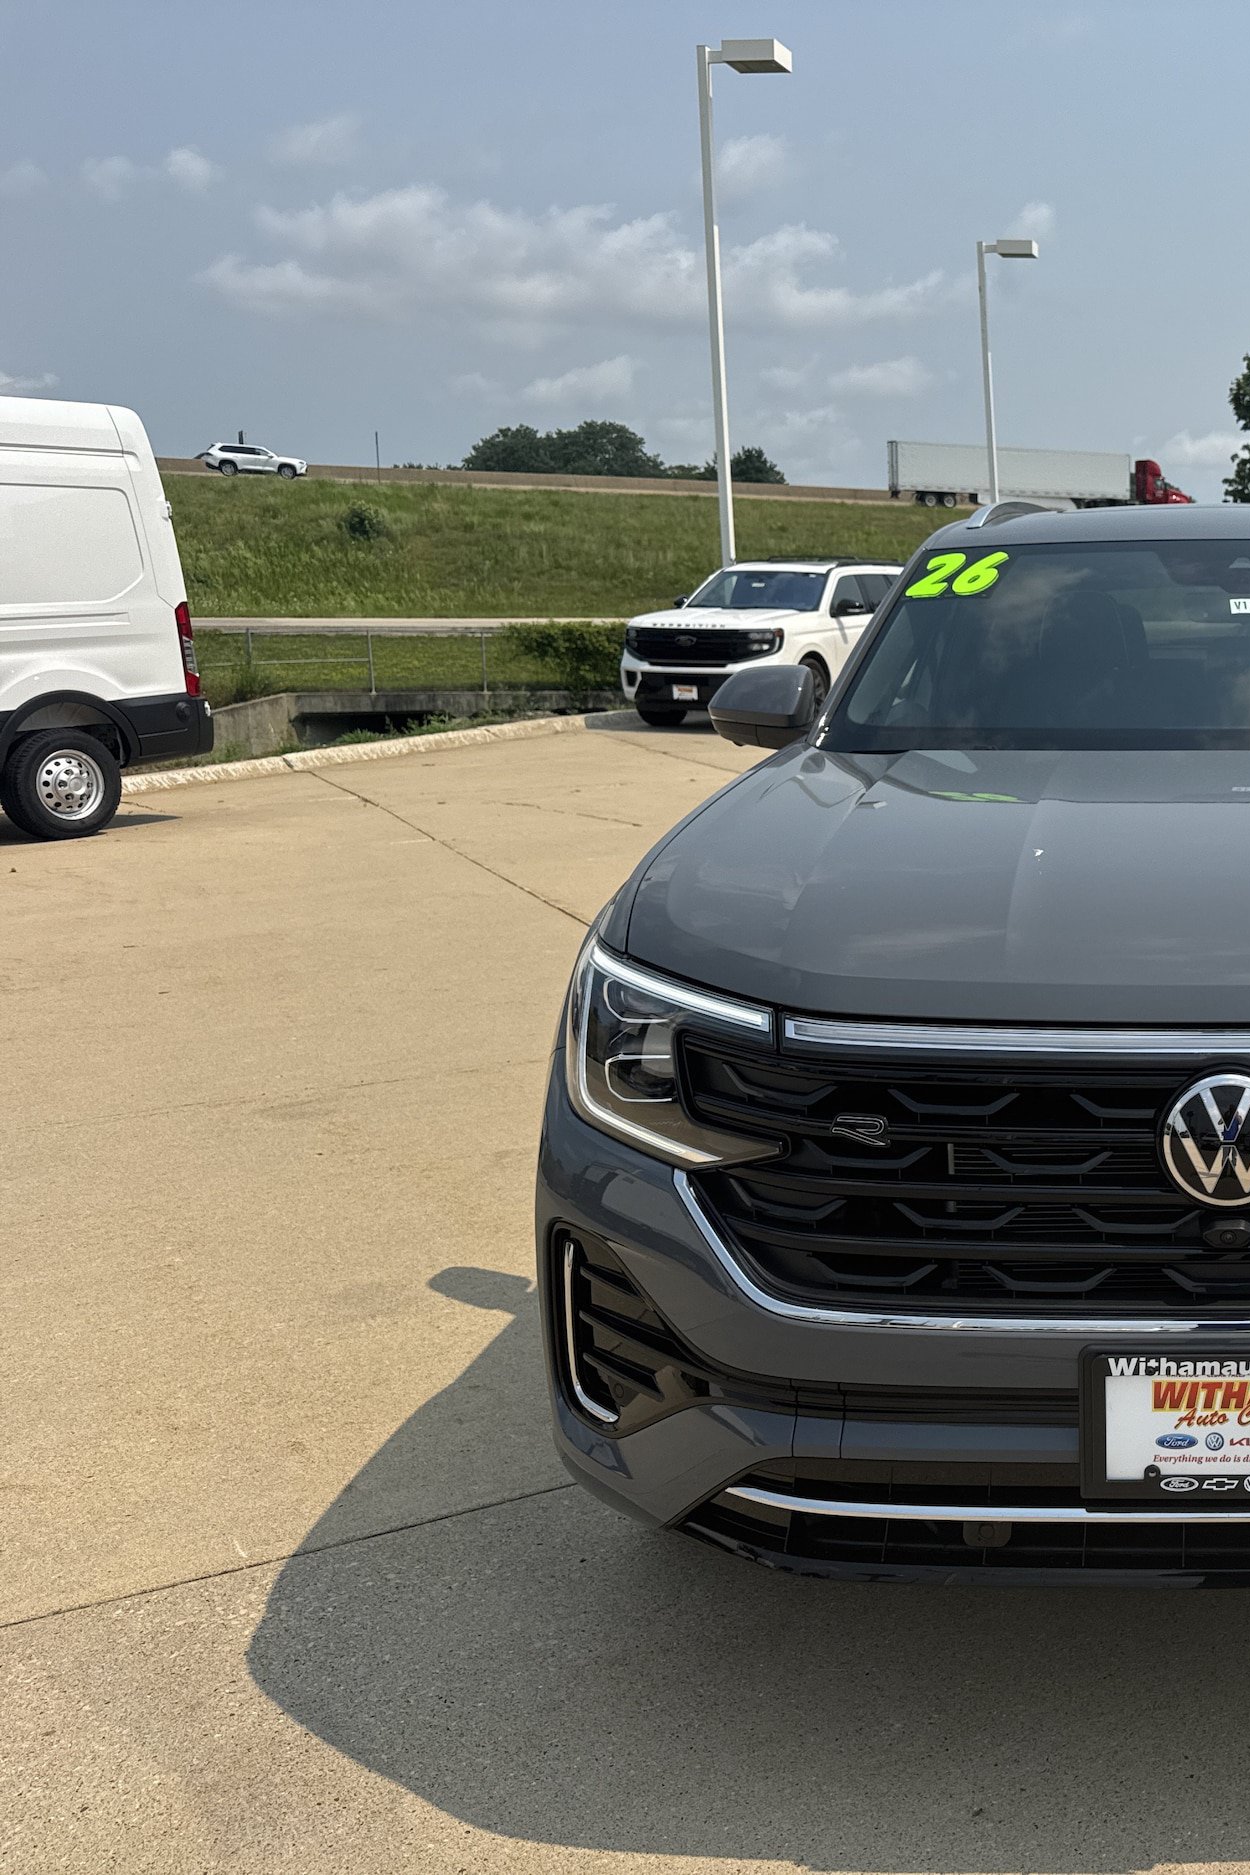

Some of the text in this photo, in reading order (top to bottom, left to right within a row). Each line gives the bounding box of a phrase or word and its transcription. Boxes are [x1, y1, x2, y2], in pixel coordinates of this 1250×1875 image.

[905, 551, 1010, 599] 26
[1174, 1406, 1230, 1430] Auto
[1153, 1454, 1203, 1464] Everything
[1219, 1455, 1232, 1463] do
[1233, 1455, 1241, 1463] is
